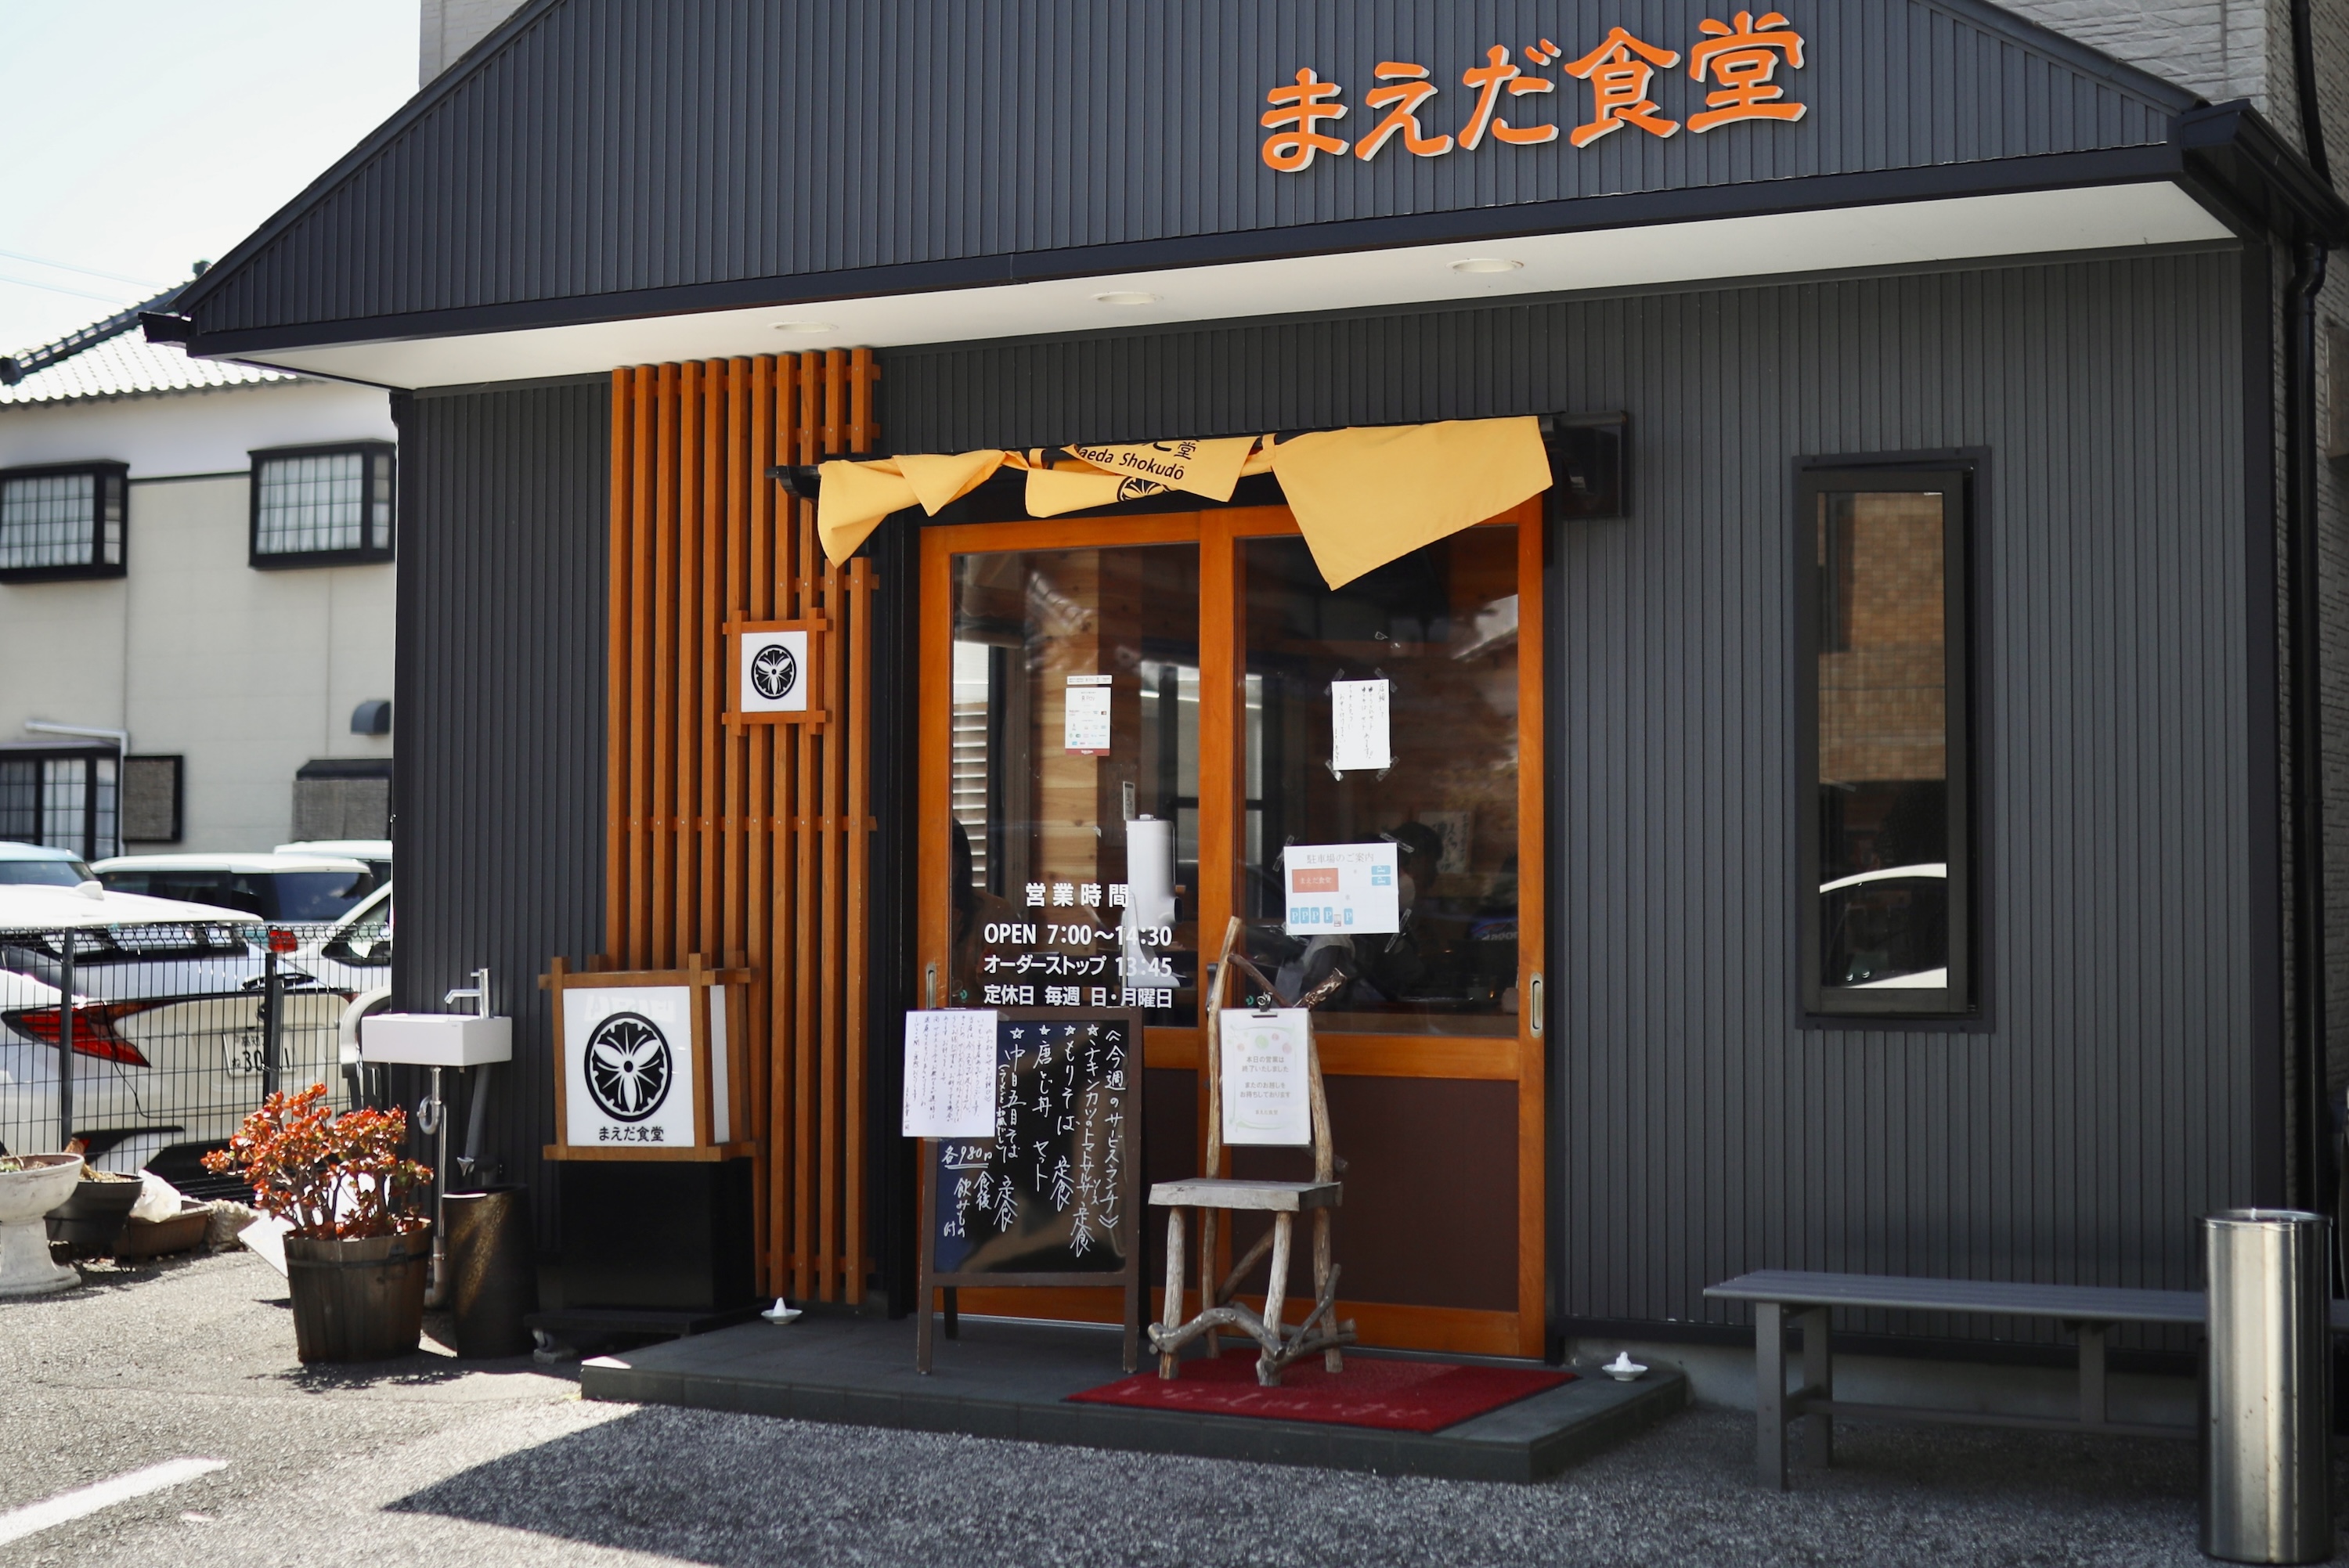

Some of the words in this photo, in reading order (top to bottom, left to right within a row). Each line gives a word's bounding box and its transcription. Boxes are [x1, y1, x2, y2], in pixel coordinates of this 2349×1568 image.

[1261, 10, 1806, 173] まえだ食堂
[1076, 446, 1114, 463] aeda
[1119, 452, 1184, 480] Shokudô
[1307, 852, 1374, 864] 駐車場のご案内
[1026, 882, 1130, 908] 営業時間
[1291, 912, 1298, 921] P
[1302, 912, 1308, 921] P
[1312, 912, 1319, 921] P
[1326, 911, 1332, 920] P
[1345, 912, 1352, 921] P
[983, 923, 1037, 944] OPEN
[983, 954, 1107, 976] オーダーストップ
[1115, 957, 1172, 977] 13:45
[983, 984, 1034, 1006] 定休日
[1045, 985, 1081, 1007] 毎週
[1091, 987, 1172, 1009] 日・月曜日
[243, 1048, 290, 1072] 301
[1058, 1040, 1081, 1135] もりそば
[598, 1126, 664, 1142] まえだ食堂
[1033, 1141, 1049, 1191] セット
